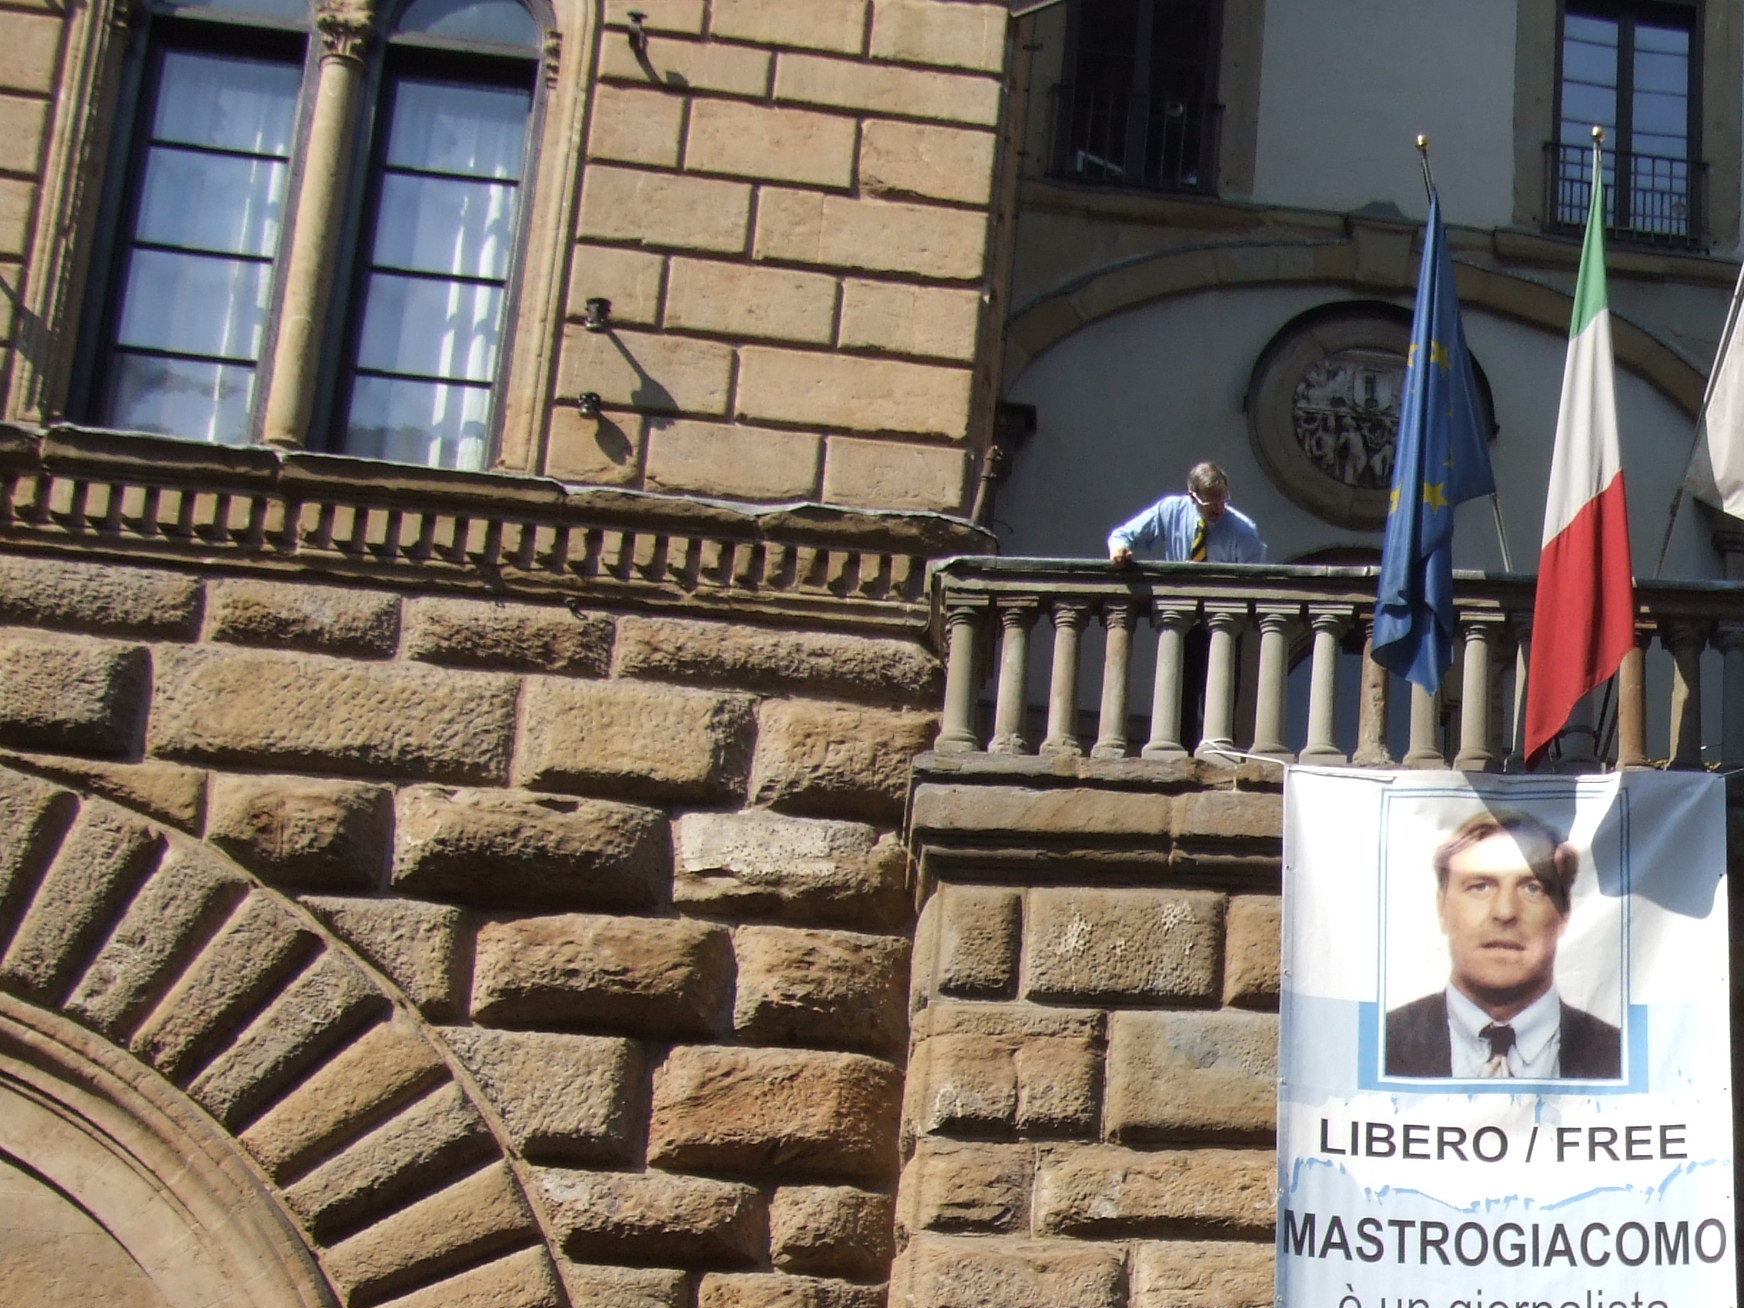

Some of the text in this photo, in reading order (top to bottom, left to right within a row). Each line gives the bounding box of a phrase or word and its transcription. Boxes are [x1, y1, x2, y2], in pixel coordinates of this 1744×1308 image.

[1318, 1117, 1689, 1163] LIBERO / FREE
[1283, 1208, 1728, 1268] MASTROGIACOMO
